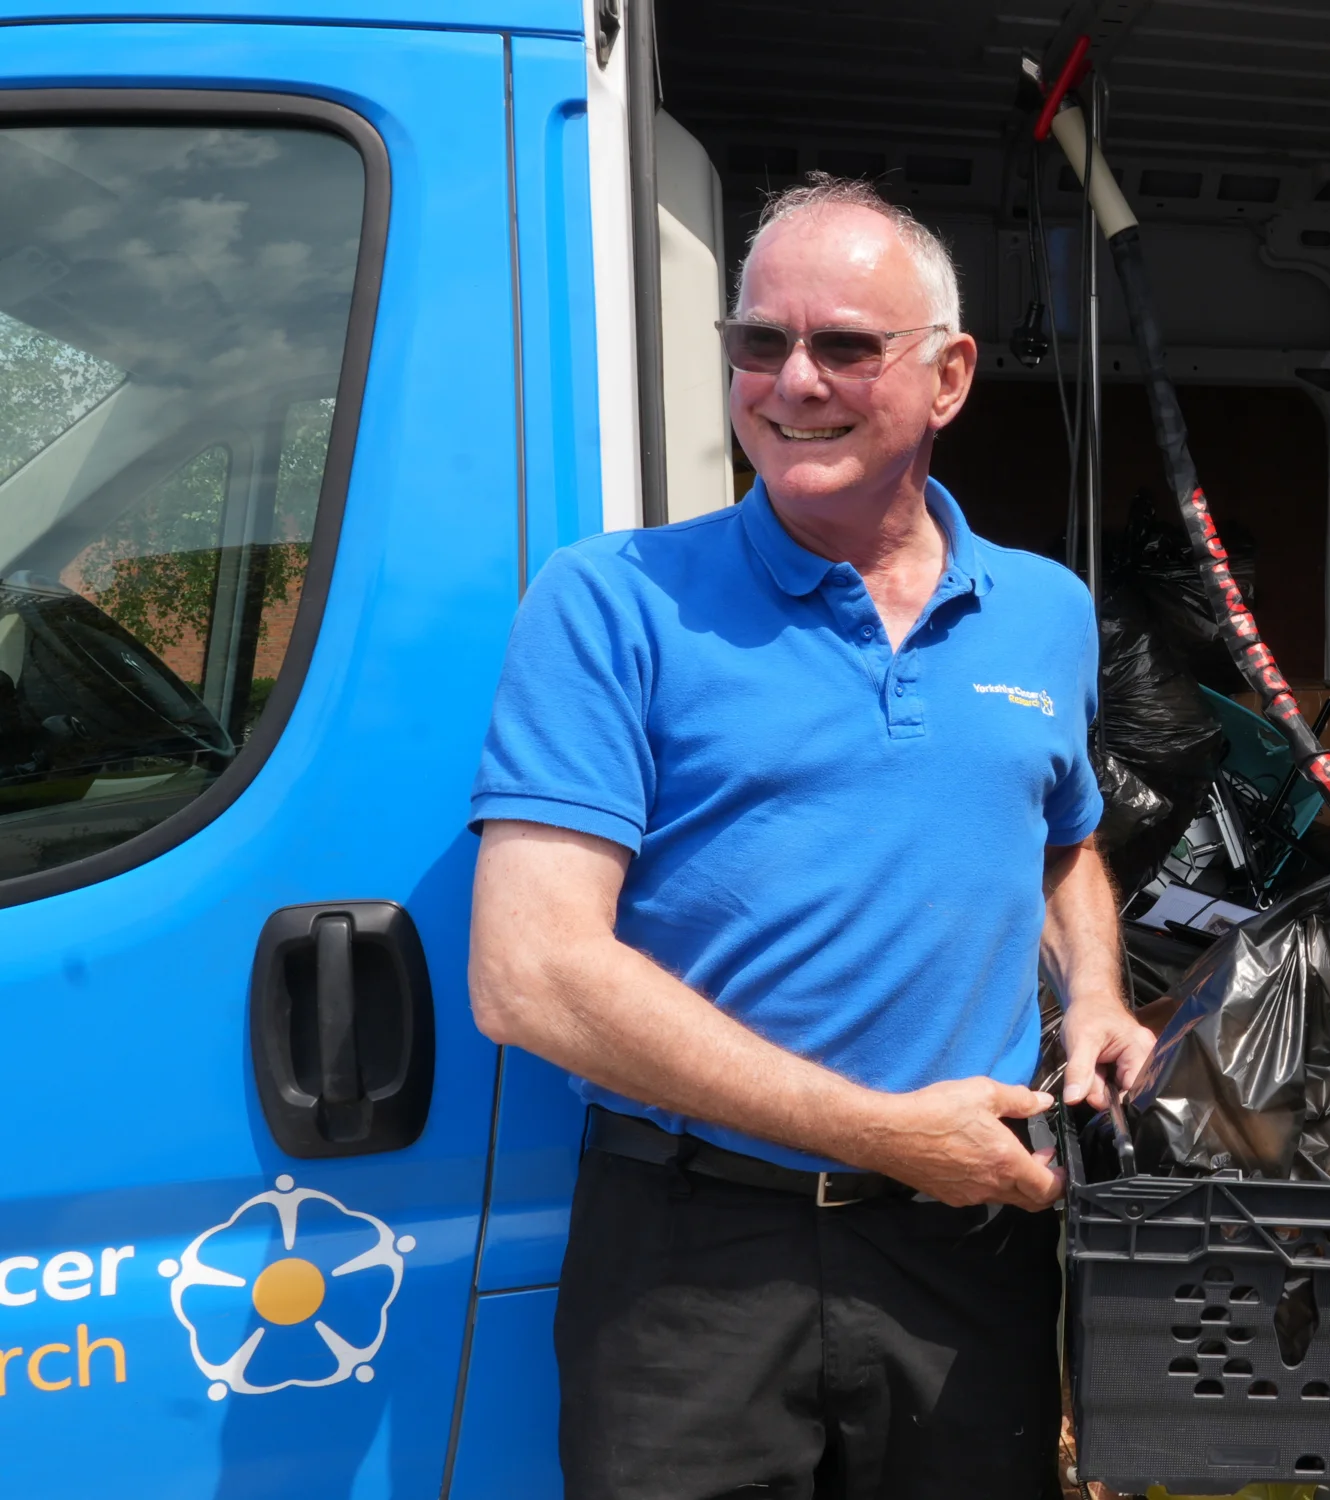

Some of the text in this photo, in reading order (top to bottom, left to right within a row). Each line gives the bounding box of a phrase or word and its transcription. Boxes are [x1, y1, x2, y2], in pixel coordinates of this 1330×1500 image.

[973, 683, 1015, 694] Yorkshire
[0, 1245, 135, 1307] cer
[0, 1323, 127, 1397] rch
